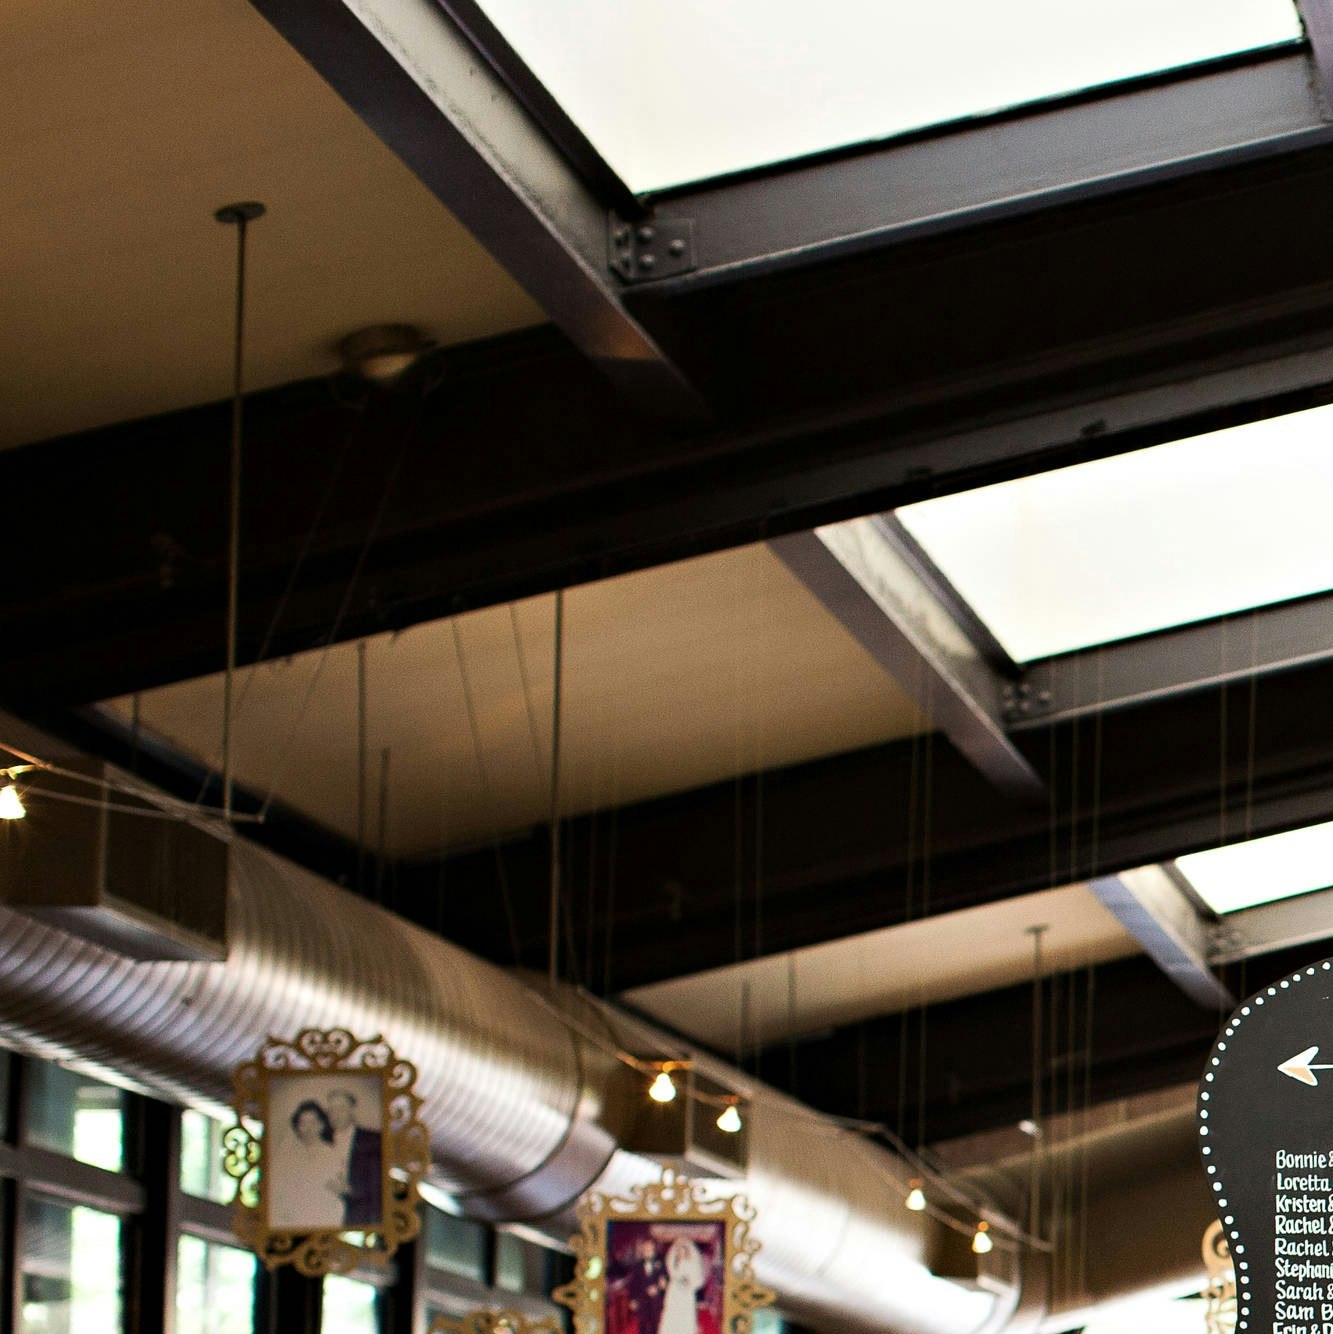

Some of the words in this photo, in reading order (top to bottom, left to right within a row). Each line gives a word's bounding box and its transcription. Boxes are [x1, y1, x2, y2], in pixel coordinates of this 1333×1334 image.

[1275, 1149, 1328, 1170] Bonnie
[1276, 1172, 1332, 1192] Loretta
[1274, 1300, 1315, 1321] Sam
